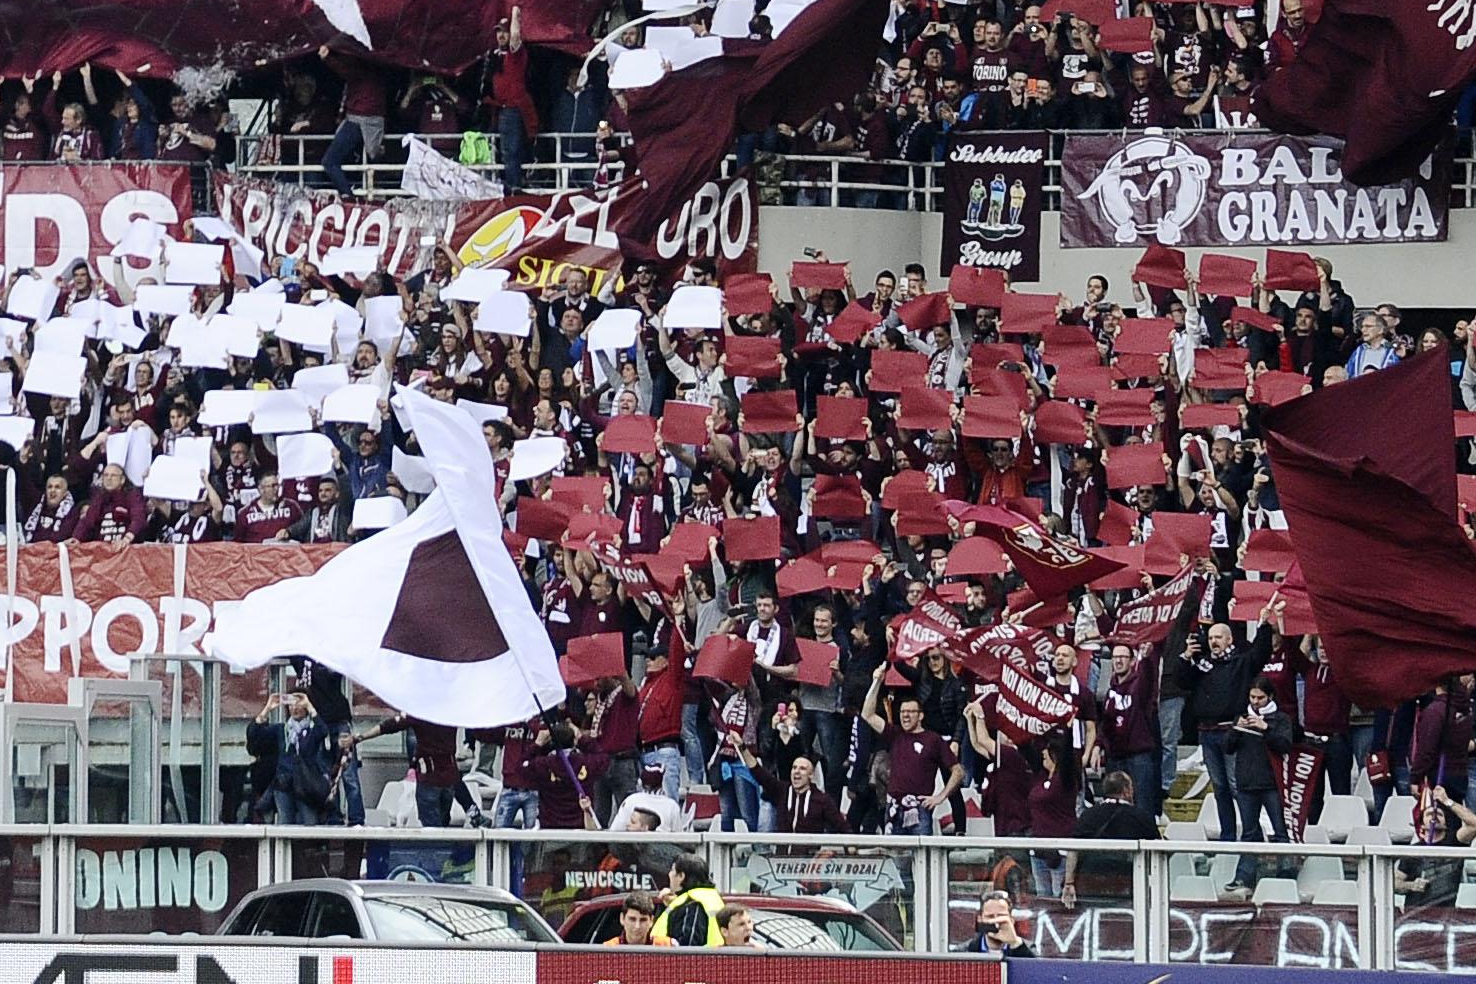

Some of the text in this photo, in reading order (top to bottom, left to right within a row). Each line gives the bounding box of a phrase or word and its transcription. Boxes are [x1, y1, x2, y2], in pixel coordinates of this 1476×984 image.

[972, 65, 1007, 81] TORINO
[1218, 145, 1344, 187] BAL
[1218, 187, 1441, 242] GRANATA
[32, 843, 229, 912] ONINO
[565, 870, 652, 890] NEWCASTLE
[775, 863, 877, 875] TENERIFE SIN BOZAL
